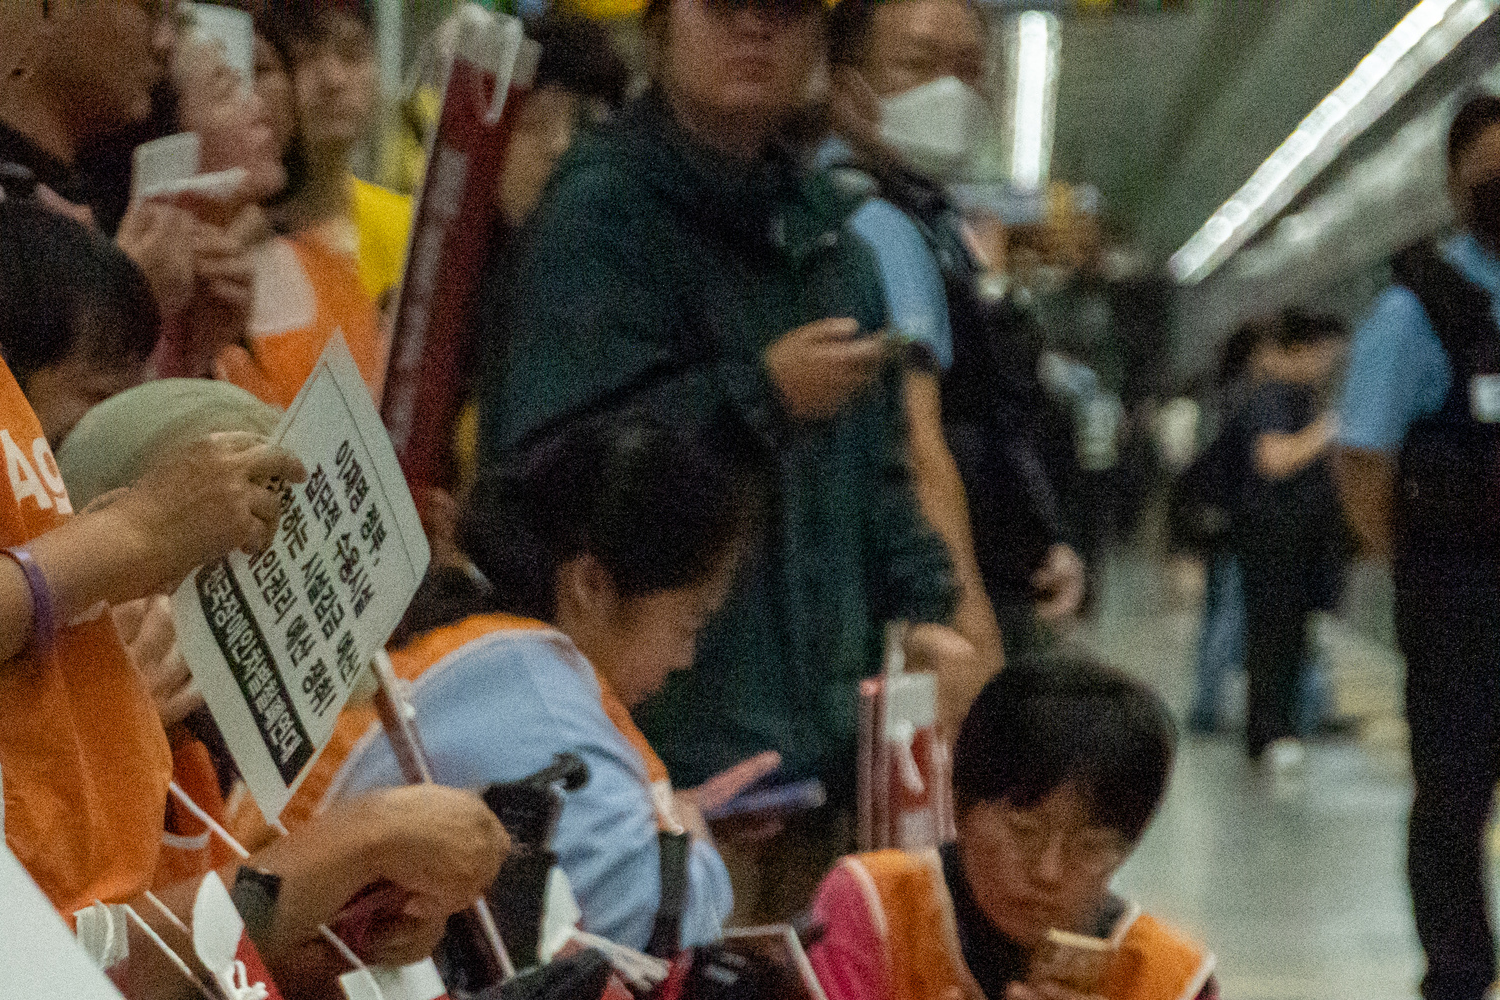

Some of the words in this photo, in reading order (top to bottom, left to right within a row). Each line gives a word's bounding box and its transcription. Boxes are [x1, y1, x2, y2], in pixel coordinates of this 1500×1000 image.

[335, 439, 370, 516] 이재명
[304, 463, 342, 541] 집단적
[334, 531, 375, 619] 수용시설
[248, 542, 298, 625] 인권리
[286, 613, 317, 668] 예산
[301, 552, 346, 642] 시설감금
